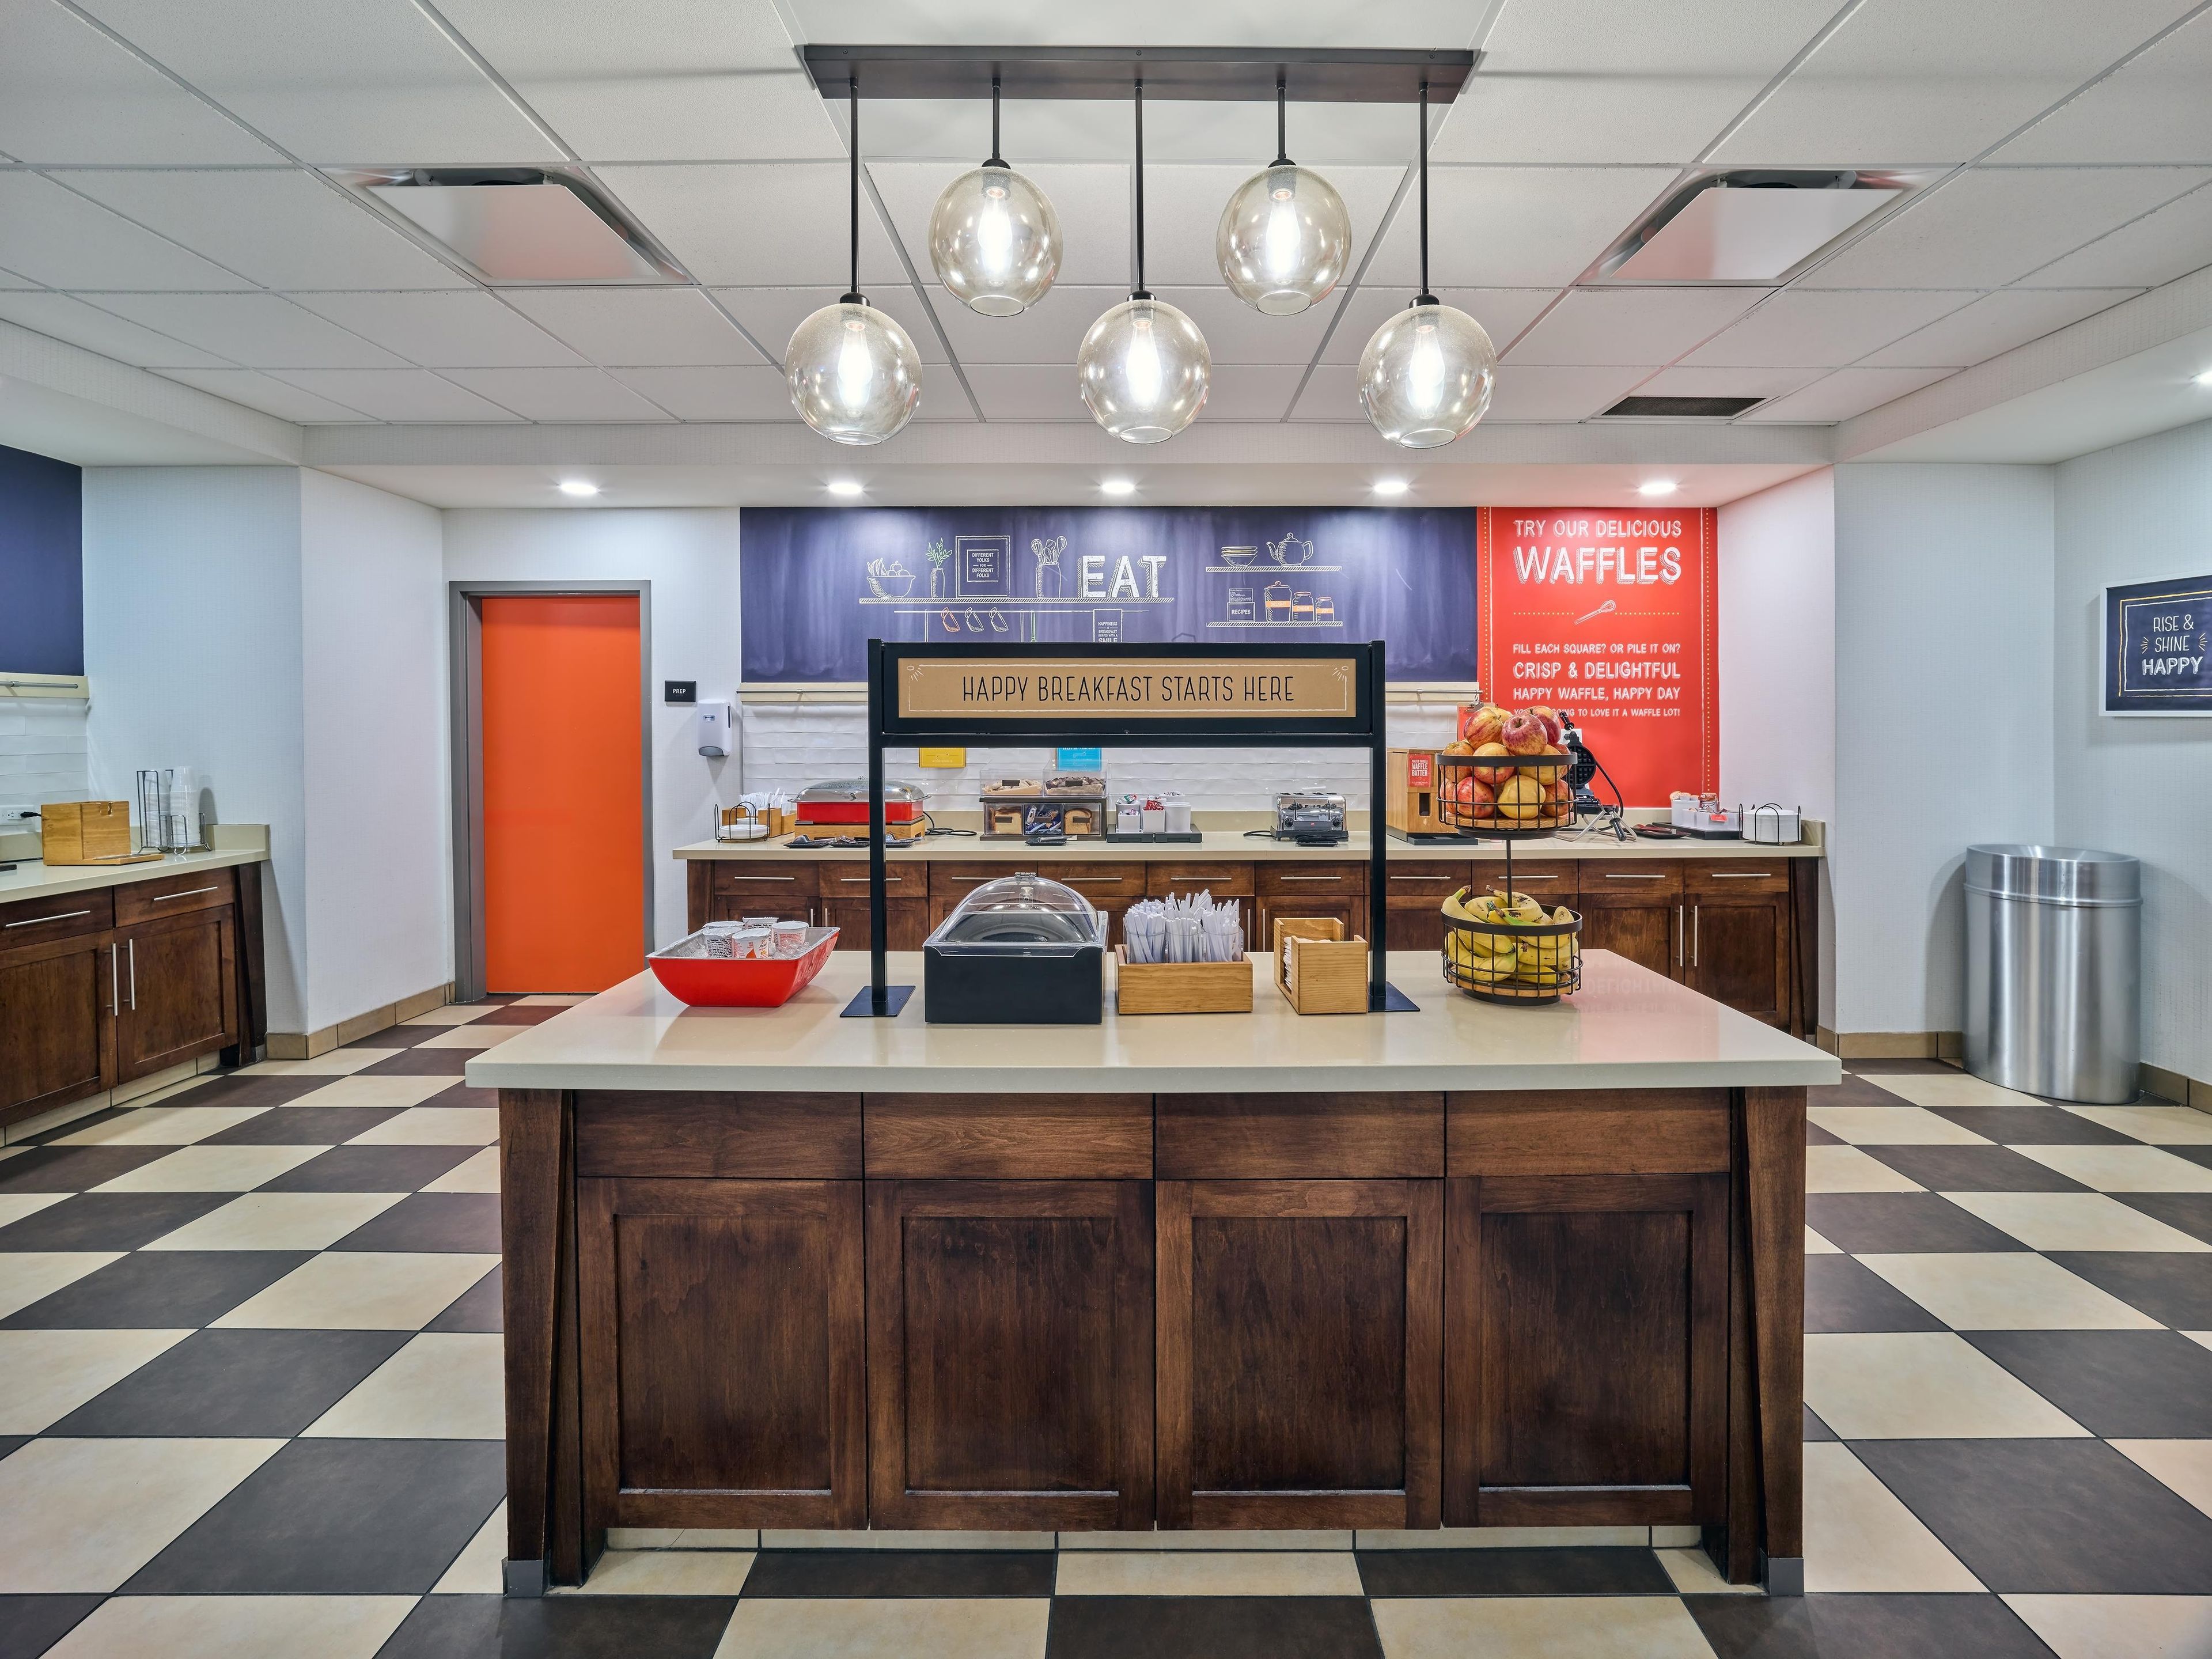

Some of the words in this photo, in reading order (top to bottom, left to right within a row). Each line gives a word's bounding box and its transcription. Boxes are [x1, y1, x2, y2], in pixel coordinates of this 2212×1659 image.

[1514, 520, 1546, 537] TRY
[1553, 520, 1589, 538] OUR
[1596, 520, 1682, 538] DELICIOUS
[1513, 546, 1681, 585] WAFFLES
[1077, 555, 1167, 598] EAT
[2153, 615, 2179, 632] RISE
[2183, 614, 2194, 630] &
[1513, 643, 1531, 654] FILL
[1535, 643, 1560, 654] EACH
[1563, 643, 1606, 654] SQUARE?
[1610, 643, 1624, 654] OR
[1627, 643, 1647, 654] PILE
[1650, 643, 1658, 654] IT
[1662, 643, 1680, 654] ON?
[2154, 635, 2190, 653] SHINE
[1513, 662, 1561, 679] CRISP
[1568, 661, 1578, 679] &
[1585, 661, 1681, 679] DELIGHTFUL
[2142, 656, 2203, 676] HAPPY
[963, 676, 1028, 701] HAPPY
[1039, 676, 1153, 701] BREAKFAST
[1162, 676, 1233, 701] STARTS
[1244, 676, 1294, 701] HERE
[1513, 687, 1553, 700] HAPPY
[1558, 687, 1609, 701] WAFFLE,
[1613, 687, 1653, 700] HAPPY
[1657, 687, 1680, 700] DAY
[1578, 709, 1588, 717] TO
[1590, 709, 1610, 717] LOVE
[1613, 709, 1620, 717] IT
[1622, 709, 1628, 717] A
[1631, 709, 1661, 717] WAFFLE
[1663, 709, 1680, 717] LOT!
